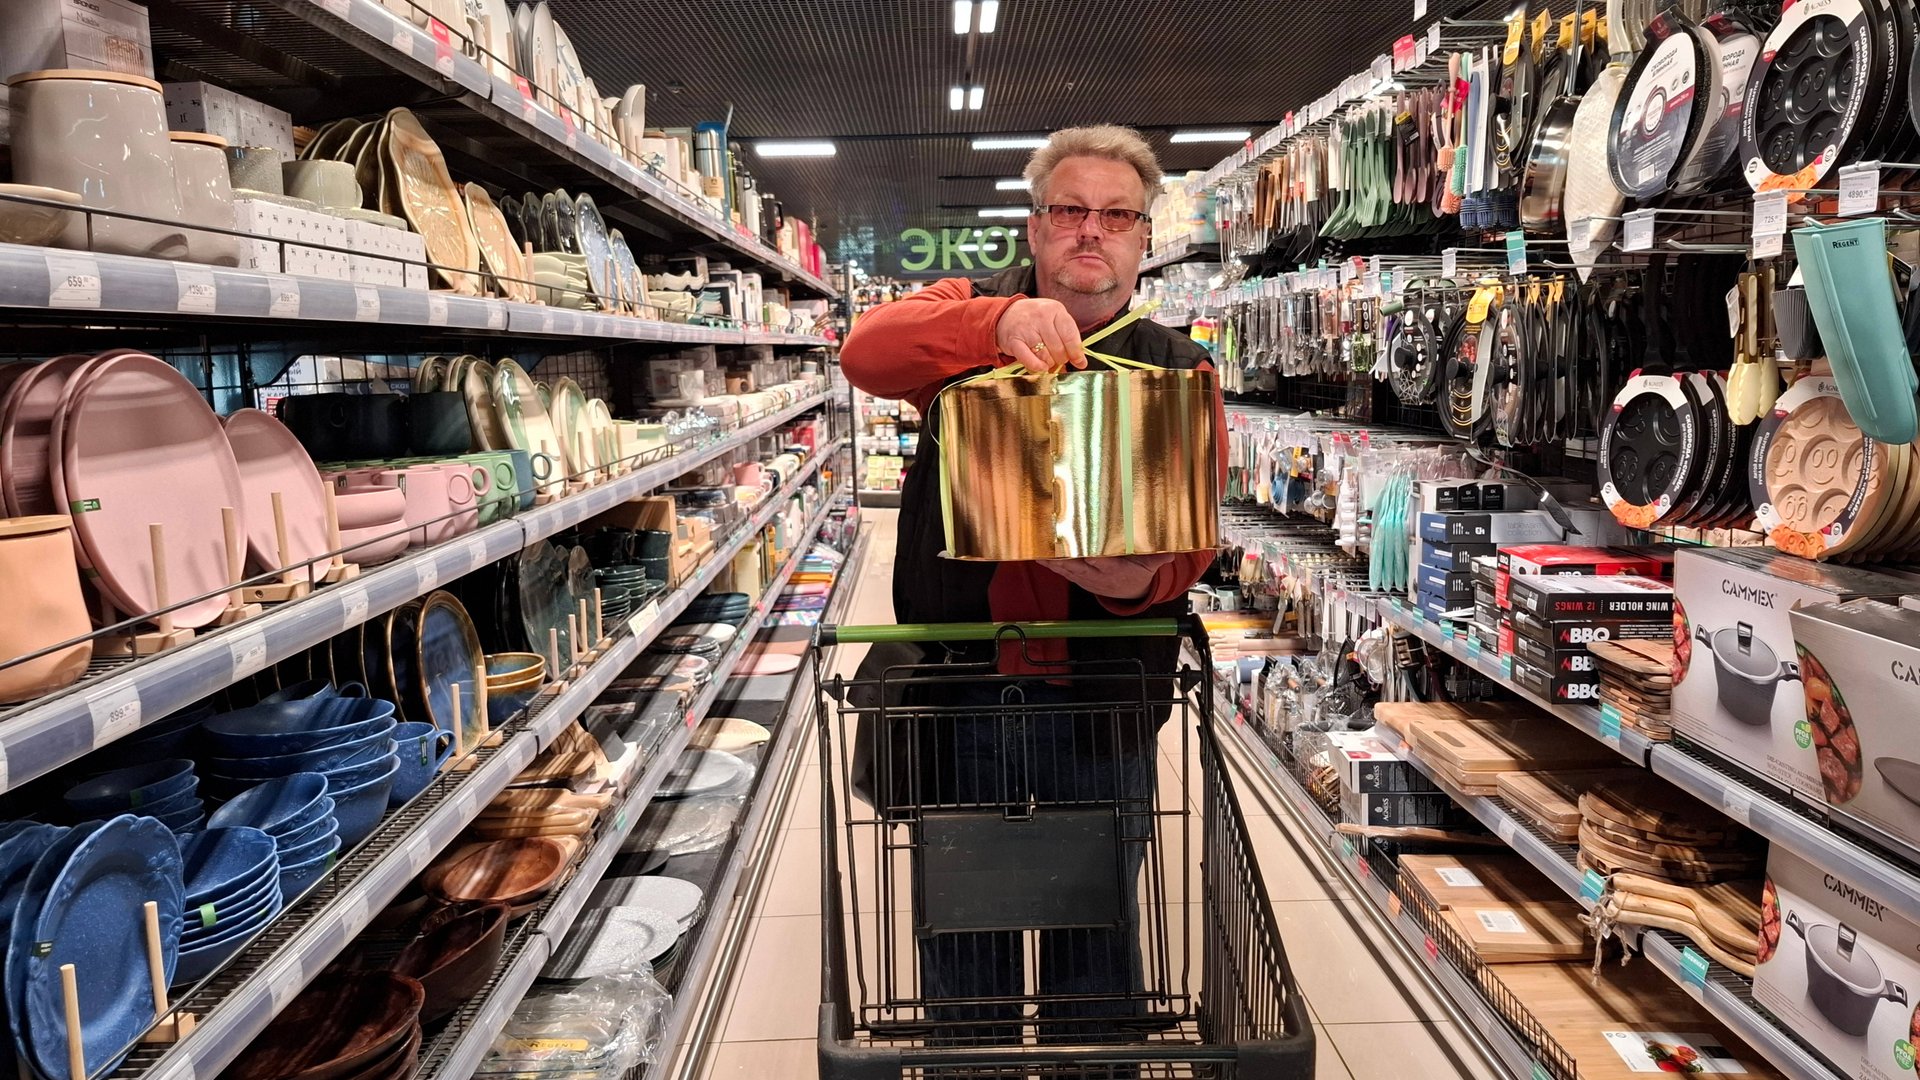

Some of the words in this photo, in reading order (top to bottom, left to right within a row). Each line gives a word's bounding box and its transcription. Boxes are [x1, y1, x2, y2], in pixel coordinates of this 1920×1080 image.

[1722, 49, 1745, 63] ВОРОДА
[1858, 25, 1868, 87] СКОВОРОДА
[900, 226, 1031, 271] ЭКО.
[1832, 239, 1859, 249] REGENT
[1728, 423, 1737, 458] ОВОРОДА
[1864, 437, 1873, 480] ОВОРОДА
[1722, 578, 1775, 609] CAMMEX
[1555, 602, 1583, 611] WINGS
[1586, 602, 1595, 611] 12
[1609, 601, 1643, 611] HOLDER
[1646, 601, 1669, 611] WING
[1570, 627, 1610, 644] BBQ
[1571, 656, 1595, 672] BB
[1824, 873, 1884, 922] CAMMEX
